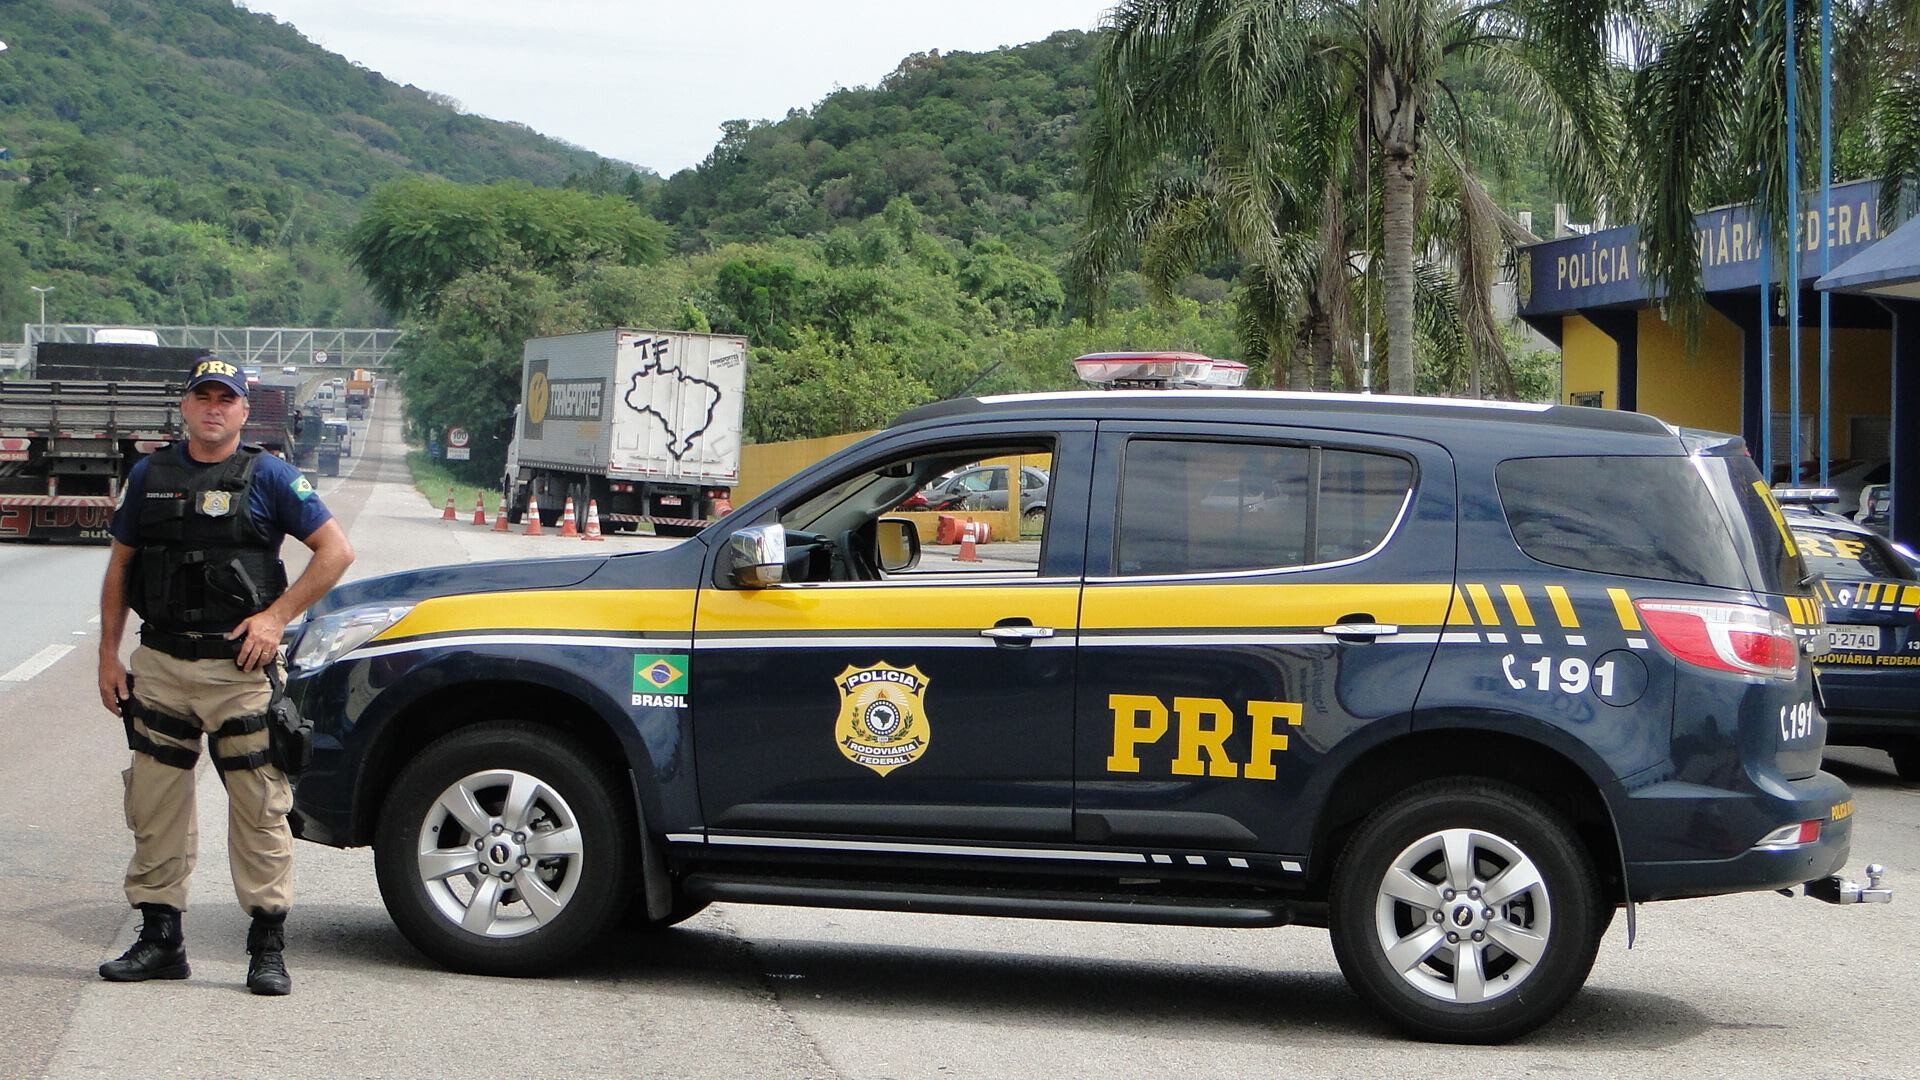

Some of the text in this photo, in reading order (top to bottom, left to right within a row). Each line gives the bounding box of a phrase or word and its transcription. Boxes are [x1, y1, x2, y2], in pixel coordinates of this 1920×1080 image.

[1557, 240, 1630, 291] POLÍCIA
[194, 360, 238, 378] PRF
[1795, 535, 1866, 560] RF
[1811, 652, 1873, 665] ODOVIÁRIA
[847, 670, 915, 688] POLÍCIA
[1531, 656, 1615, 697] 191
[631, 693, 688, 708] BRASIL
[1789, 701, 1813, 740] 191
[1106, 693, 1303, 781] PRF
[859, 756, 907, 765] FEDERAL
